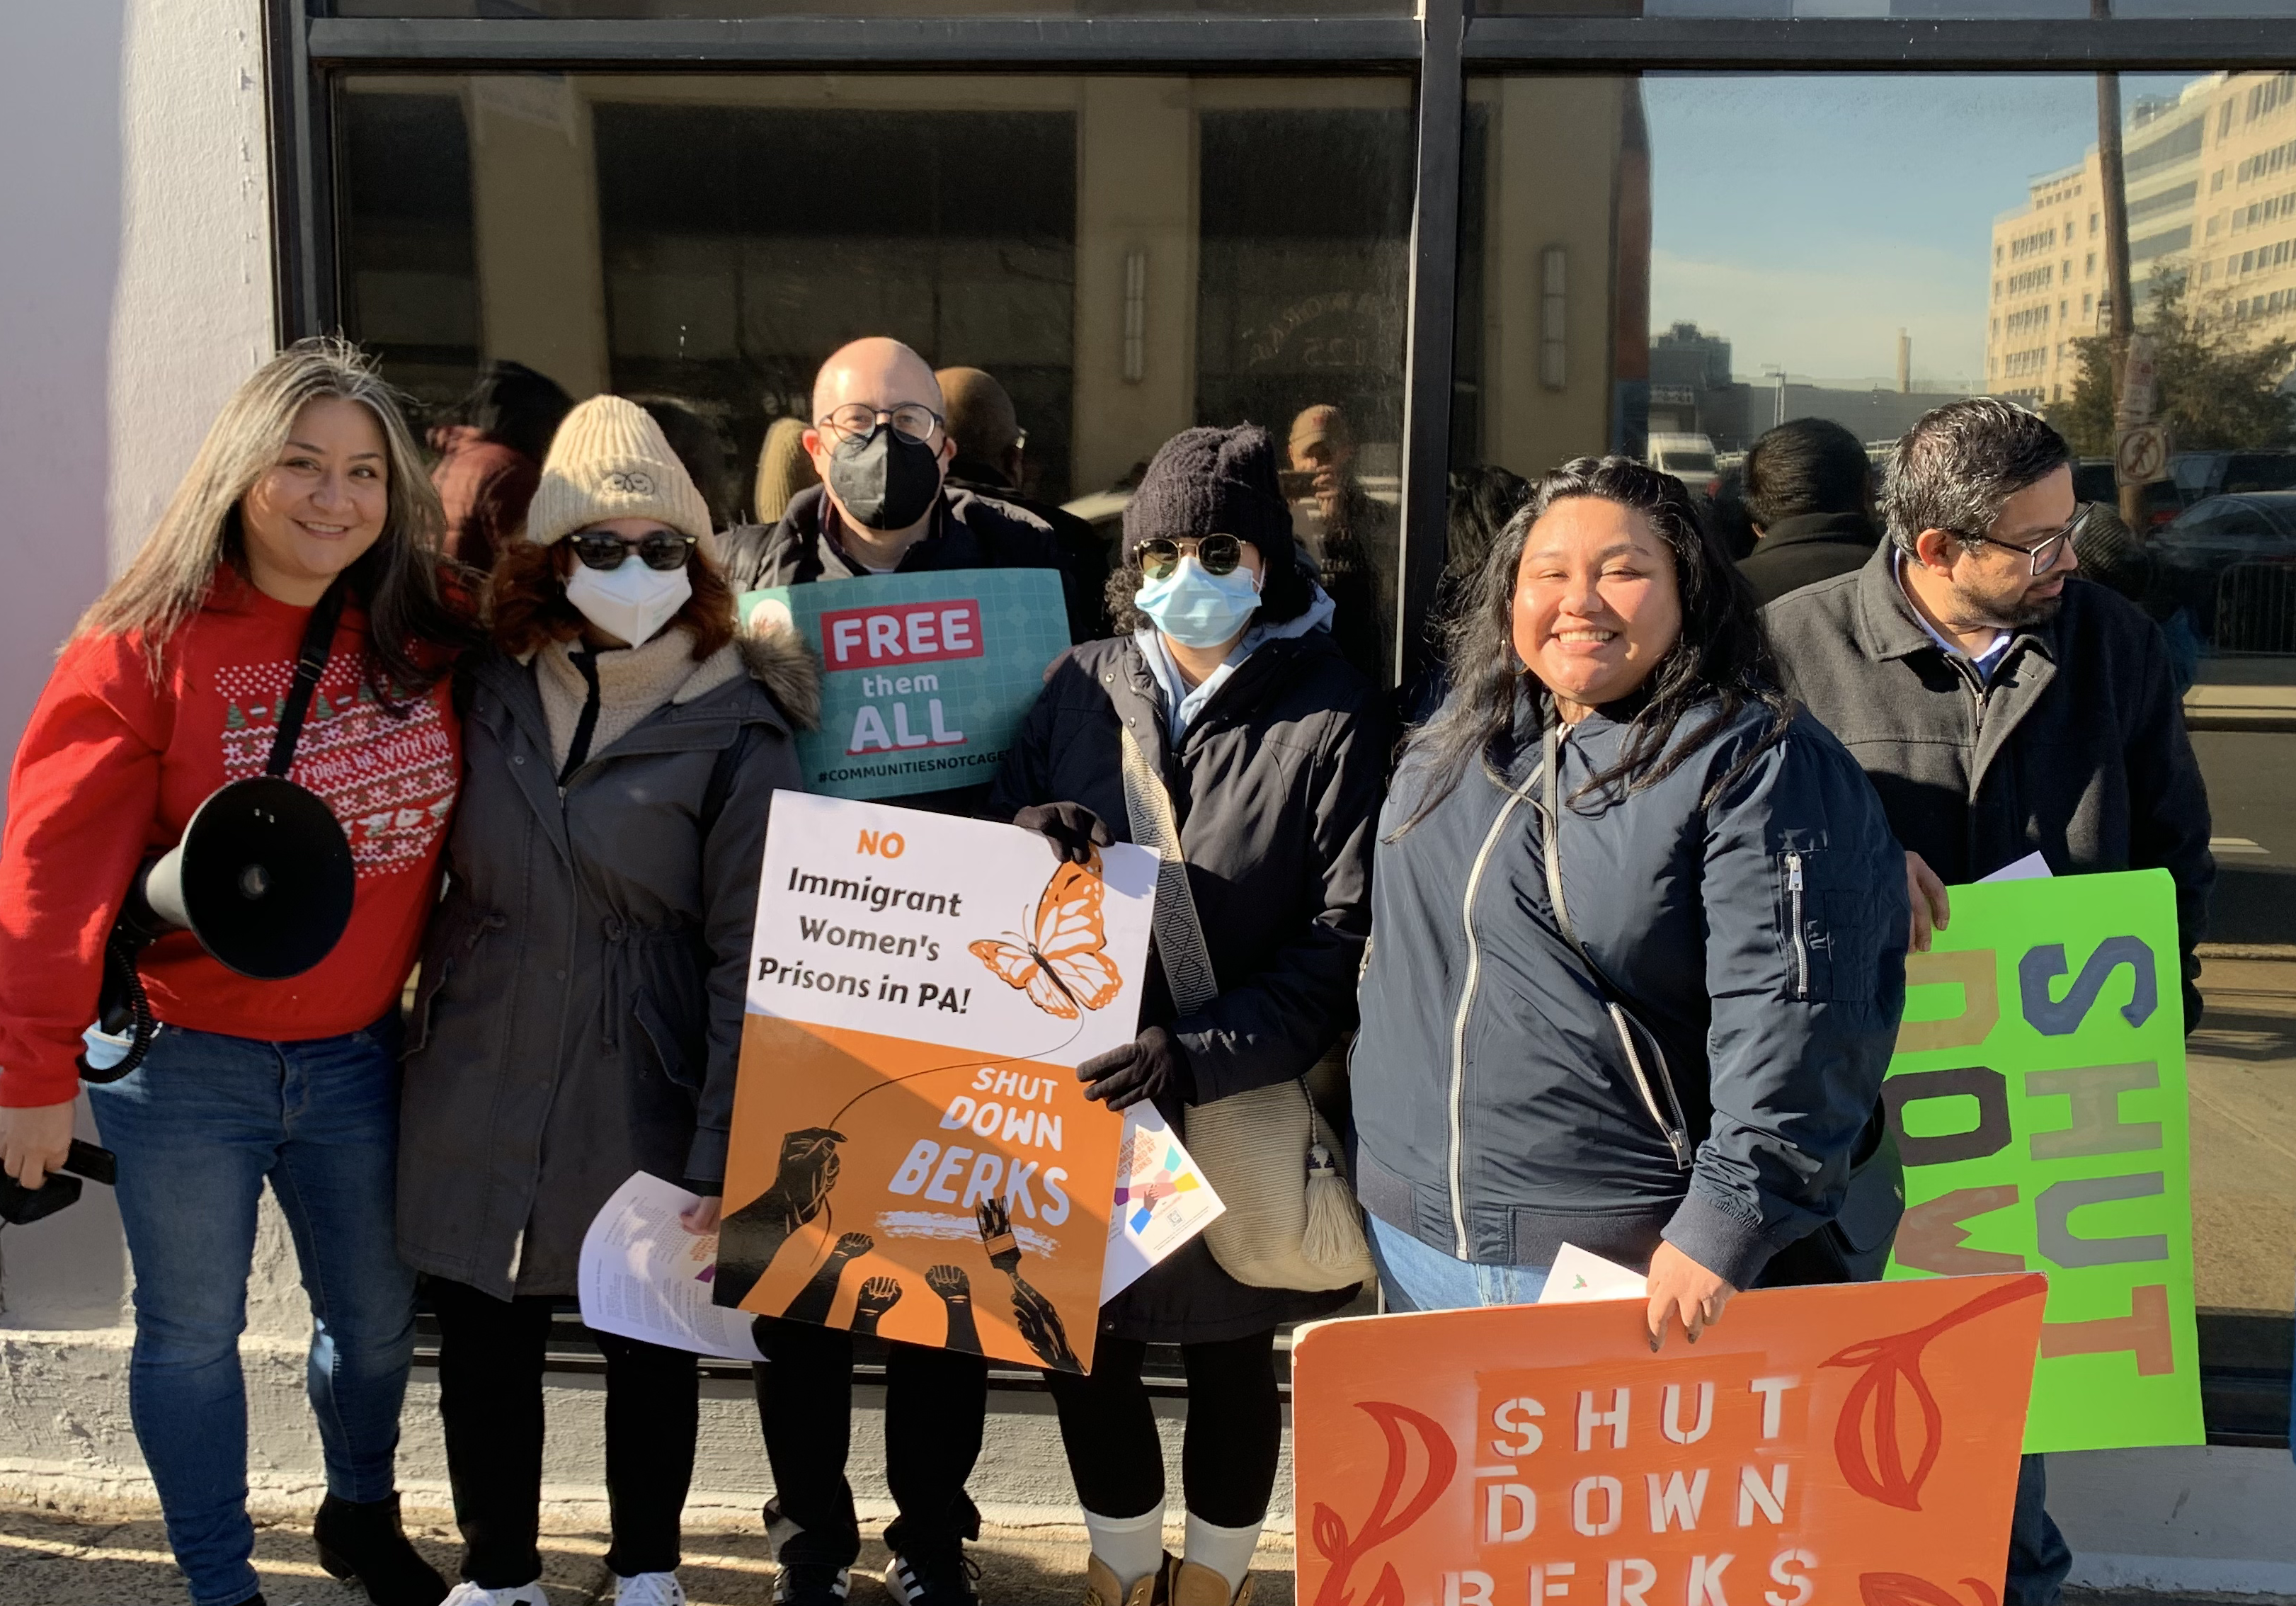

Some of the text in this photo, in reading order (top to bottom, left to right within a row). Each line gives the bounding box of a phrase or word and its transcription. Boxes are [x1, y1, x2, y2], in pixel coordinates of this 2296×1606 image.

[833, 608, 973, 662] FREE
[862, 674, 938, 697] them
[850, 699, 963, 753] ALL
[857, 828, 906, 859] NO
[787, 867, 962, 918] Immigrant
[799, 915, 940, 961] Women's
[758, 957, 971, 1015] Prisons in PA!
[971, 1067, 1058, 1105] SHUT
[1883, 949, 2026, 1277] DOW
[939, 1096, 1062, 1151] DOWN
[888, 1139, 1070, 1226] BERKS
[2018, 935, 2174, 1377] SHUT
[1491, 1376, 1799, 1458] SHUT
[1483, 1464, 1789, 1544] DOWN
